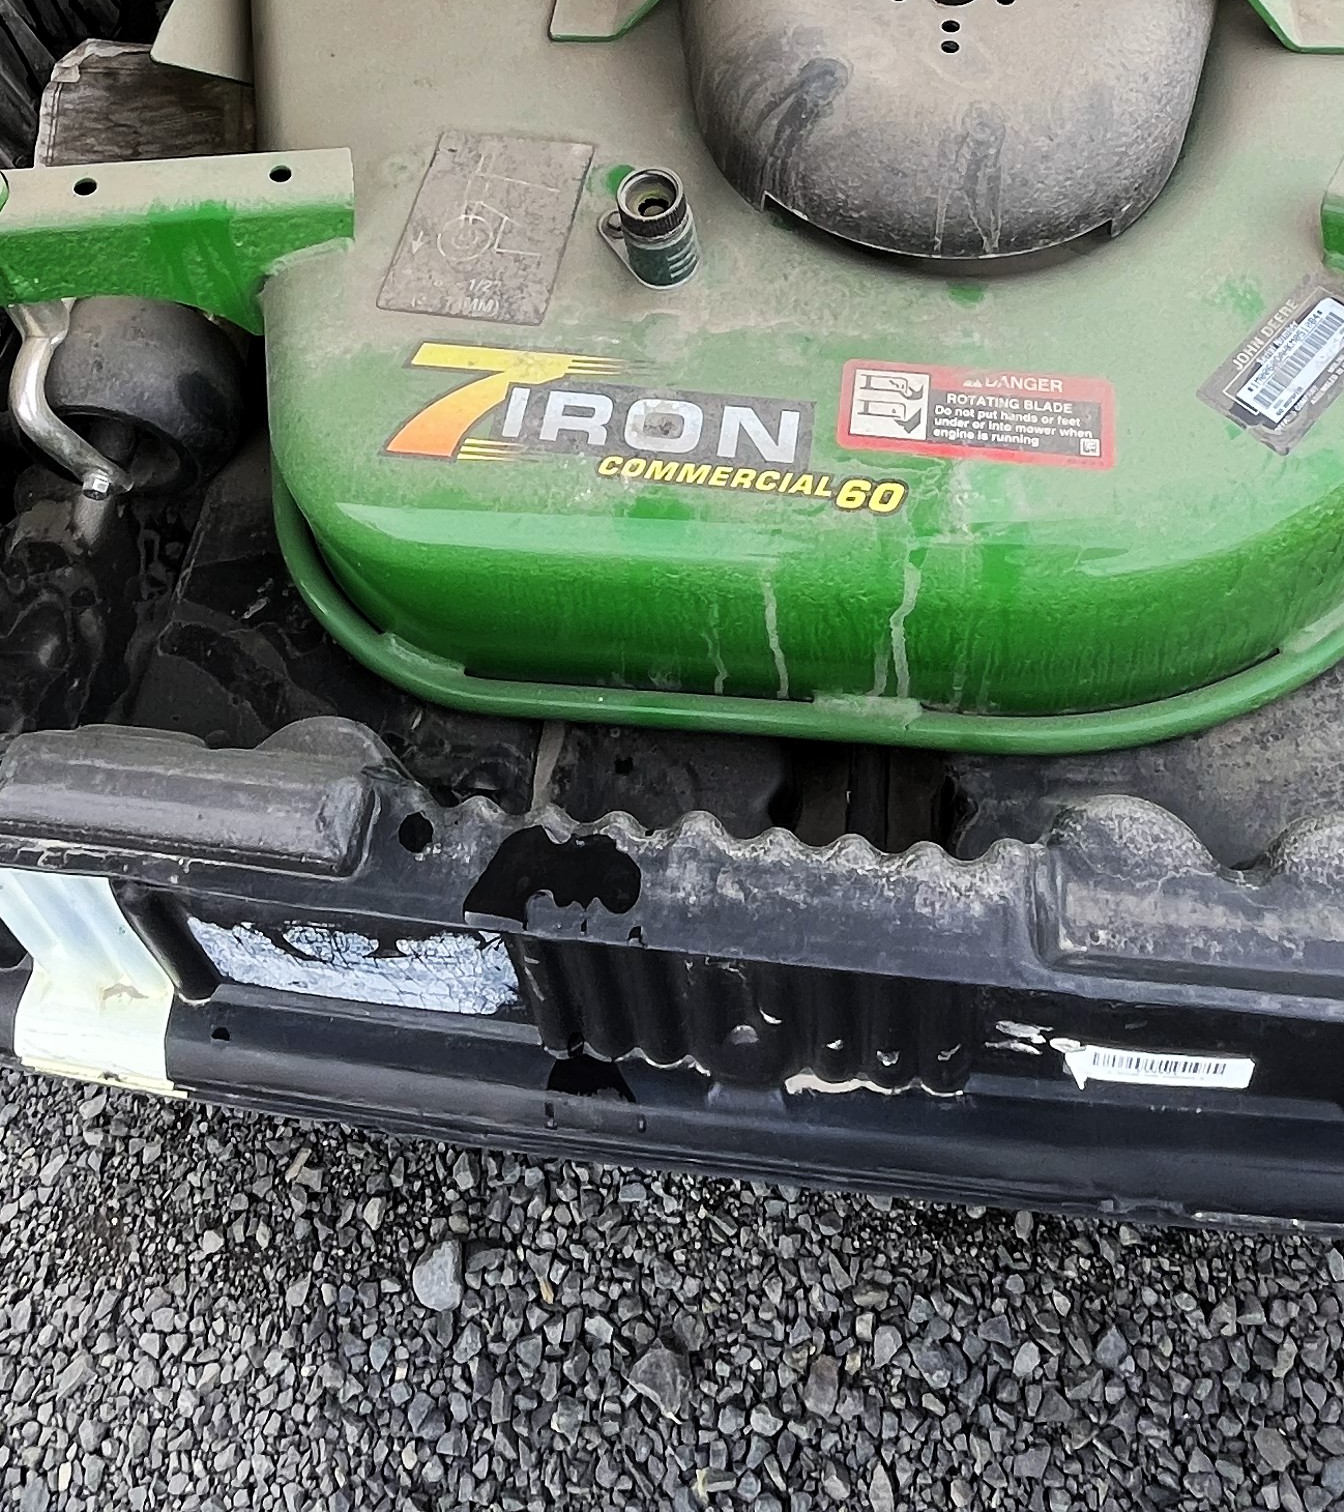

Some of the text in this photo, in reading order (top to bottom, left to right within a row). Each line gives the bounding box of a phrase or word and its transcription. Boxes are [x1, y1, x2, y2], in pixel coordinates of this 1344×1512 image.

[1232, 299, 1299, 371] JOHN DEERE
[985, 375, 1063, 393] DANGER
[946, 393, 1073, 414] ROTATING BLADE
[935, 405, 1081, 427] Do not put hands or feet
[933, 428, 1040, 447] engine is running
[934, 417, 1093, 438] under or into mower when
[598, 455, 833, 499] COMMERCIAL
